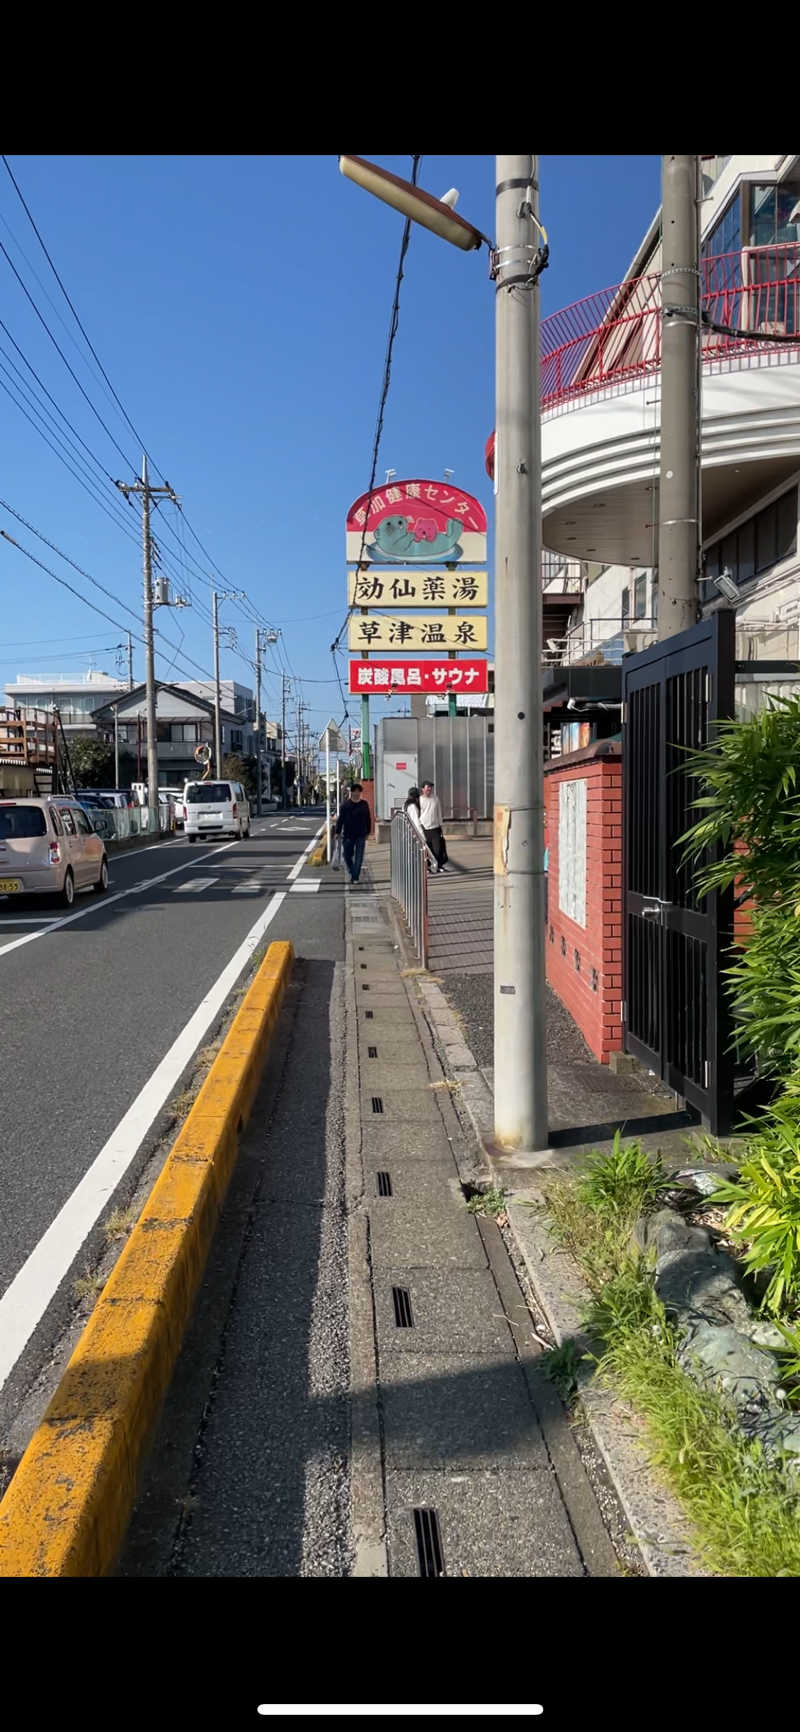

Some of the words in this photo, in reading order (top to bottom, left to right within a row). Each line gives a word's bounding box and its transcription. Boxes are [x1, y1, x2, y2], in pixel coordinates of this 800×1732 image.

[356, 576, 479, 600] 効仙薬湯
[358, 620, 478, 644] 草津温泉
[357, 667, 480, 685] 炭酸風呂・サウナ
